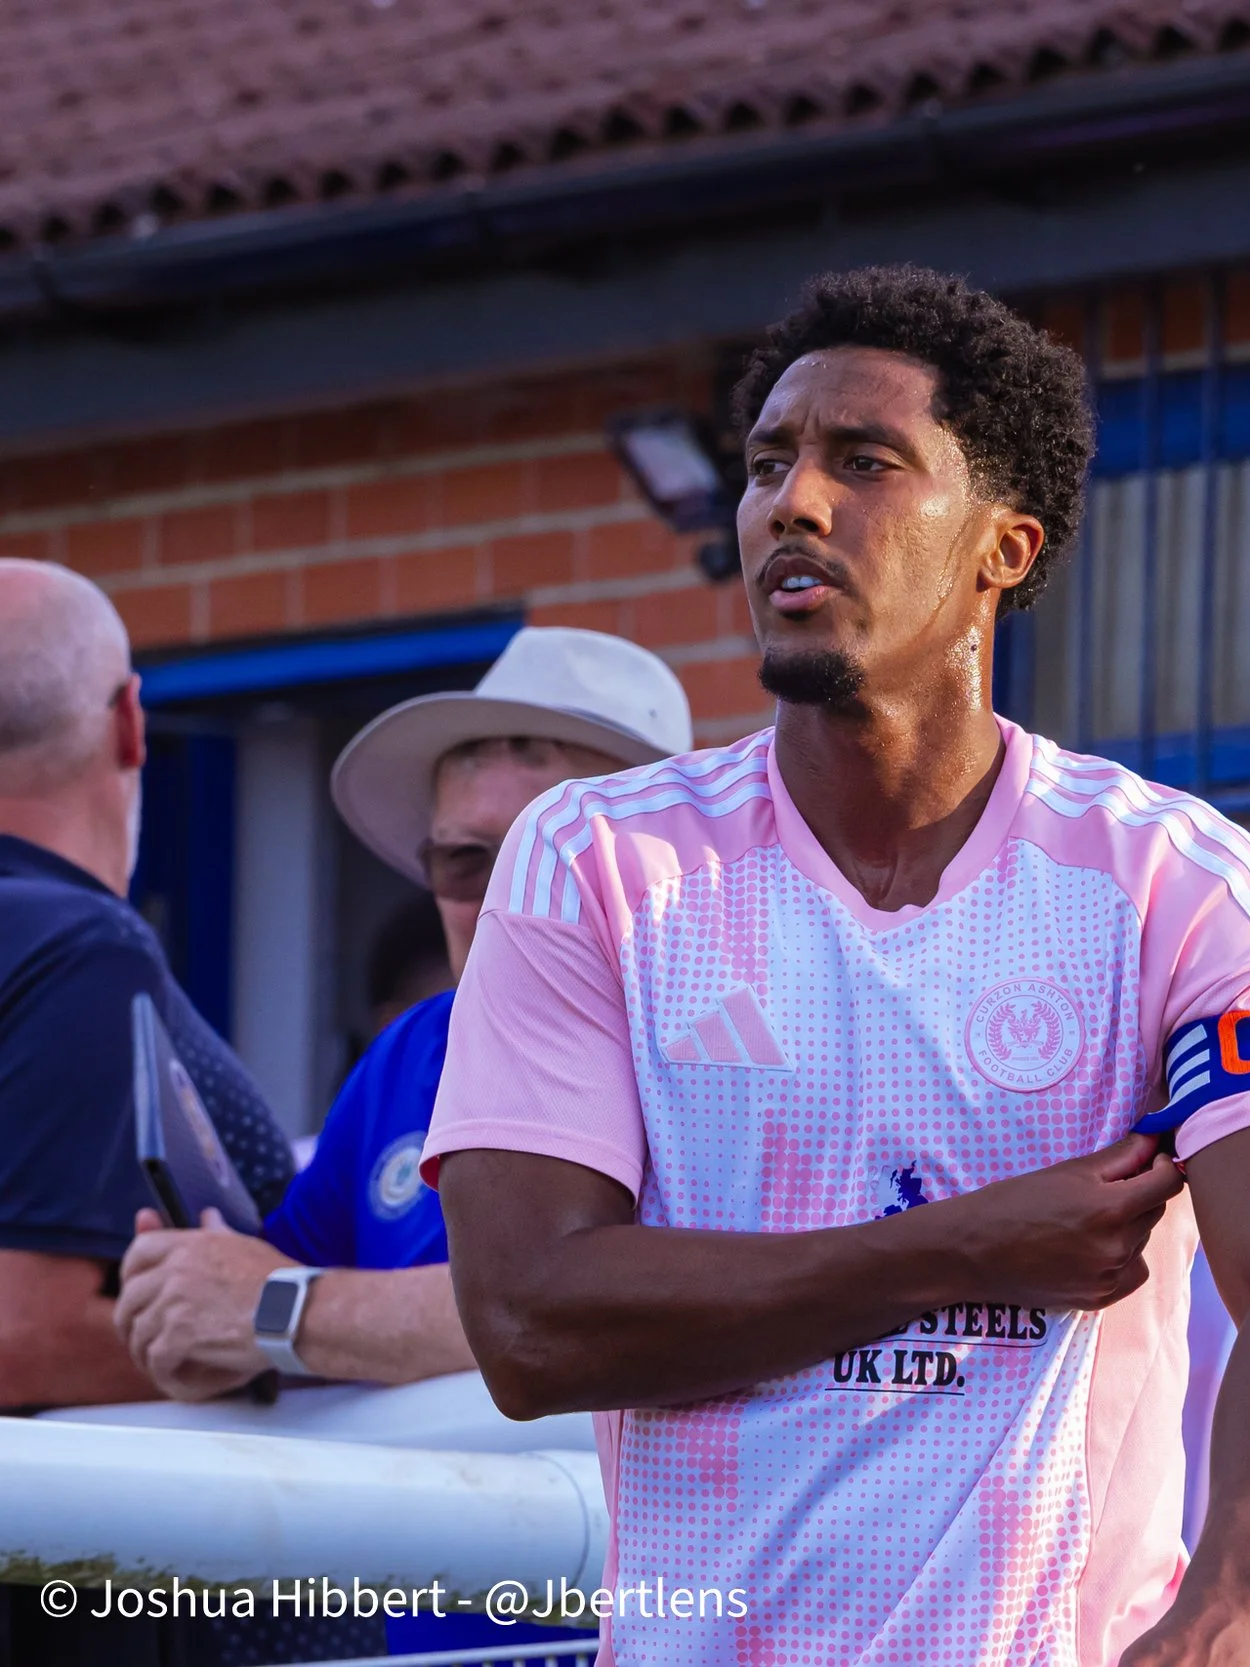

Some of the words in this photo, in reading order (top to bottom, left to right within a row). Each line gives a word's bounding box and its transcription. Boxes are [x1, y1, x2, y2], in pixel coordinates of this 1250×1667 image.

[976, 983, 1022, 1023] CURZON
[1028, 983, 1075, 1021] ASHTON
[978, 1050, 1042, 1084] FOOTBALL
[1046, 1048, 1073, 1077] CLUB
[920, 1302, 1047, 1340] STEELS
[833, 1350, 882, 1384] UK
[892, 1350, 965, 1387] LTD.
